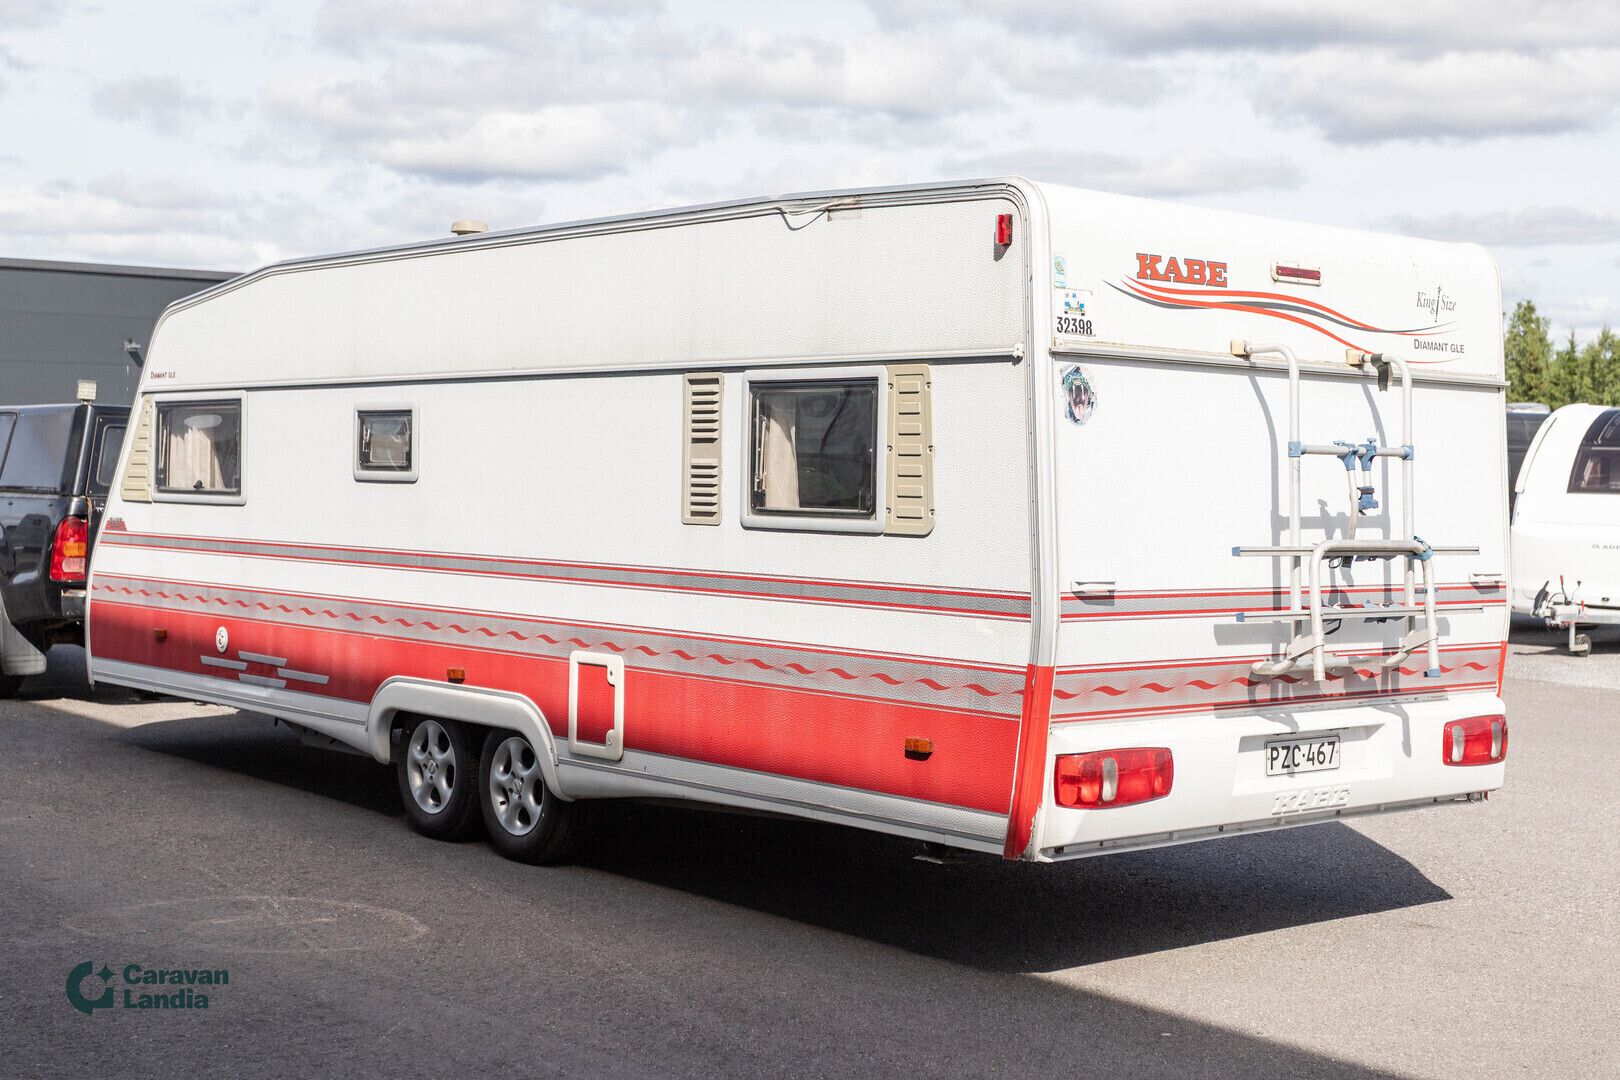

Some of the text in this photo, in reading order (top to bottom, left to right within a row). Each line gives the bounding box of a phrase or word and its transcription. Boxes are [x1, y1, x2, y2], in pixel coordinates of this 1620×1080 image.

[1136, 253, 1227, 287] KABE
[1416, 291, 1457, 314] King Size
[1056, 316, 1093, 335] 32398
[1450, 343, 1465, 354] GLE
